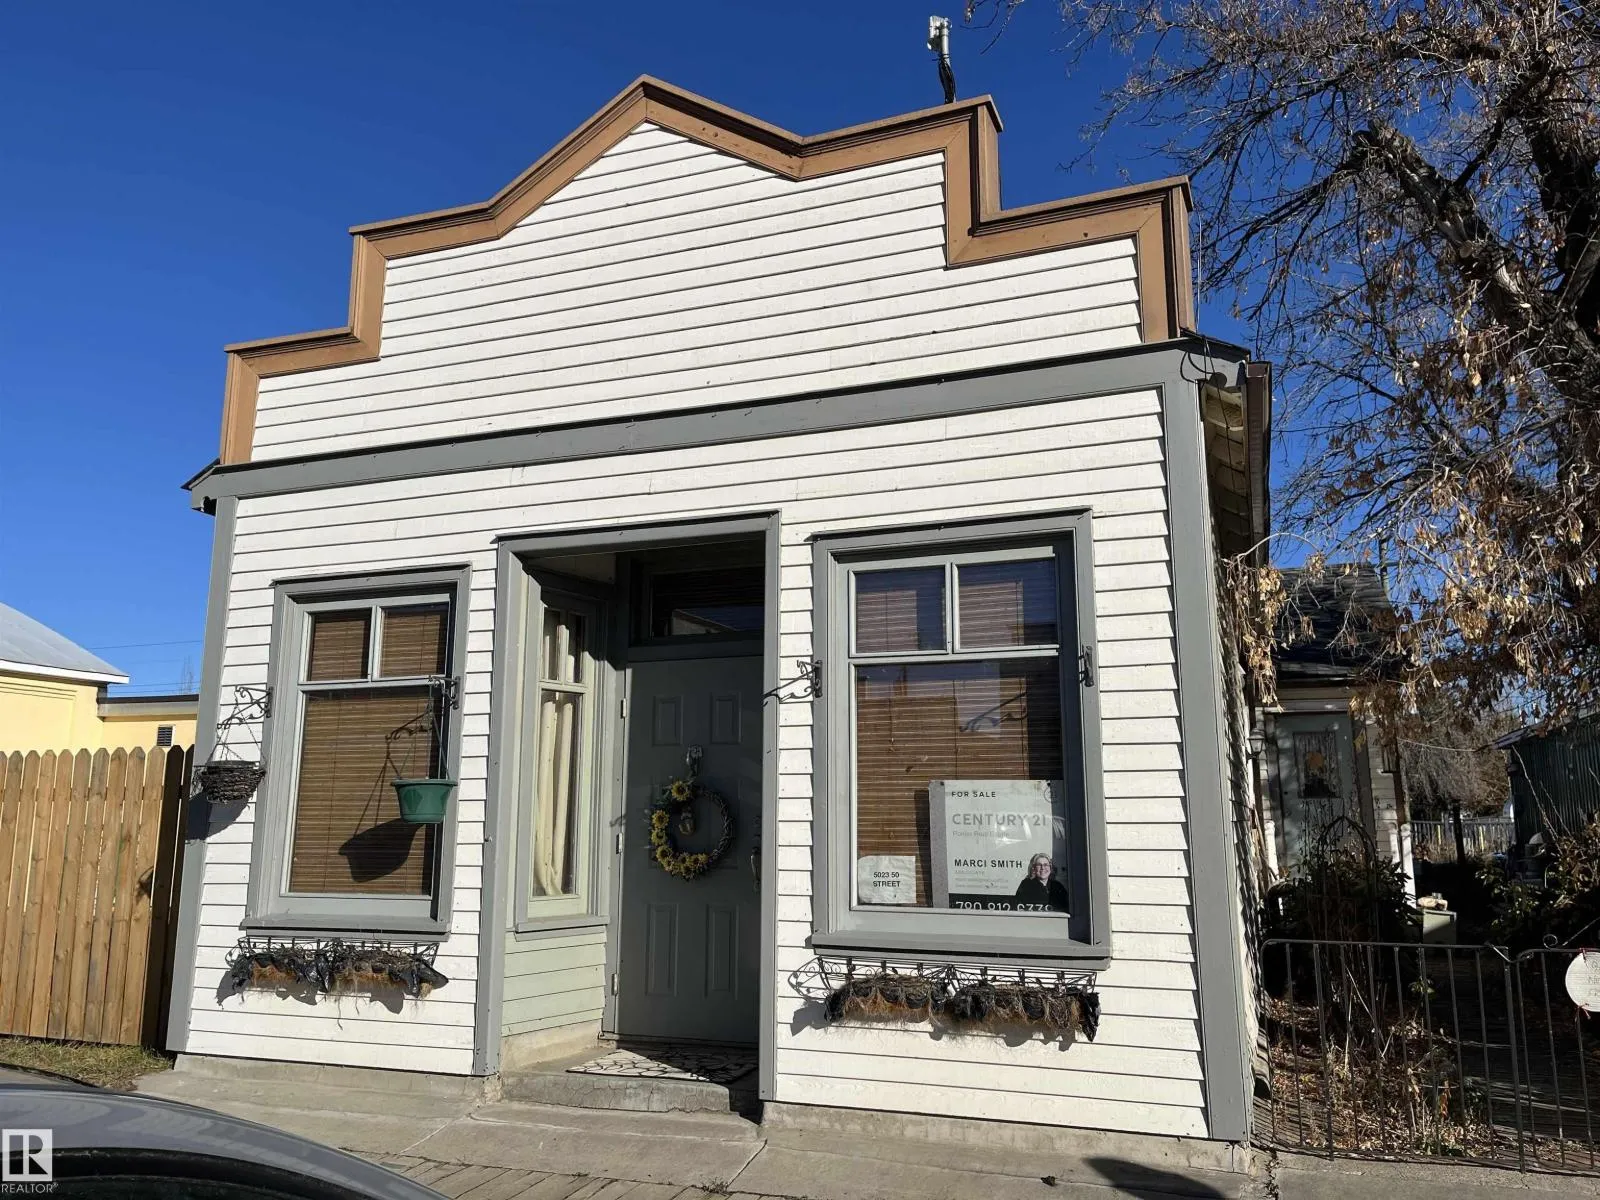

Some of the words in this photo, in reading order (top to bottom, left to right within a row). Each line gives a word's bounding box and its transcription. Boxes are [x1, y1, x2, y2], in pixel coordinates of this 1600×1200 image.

[952, 813, 1028, 826] CENTURY
[1033, 814, 1046, 826] 21
[954, 859, 987, 868] MARCI
[991, 860, 1023, 869] SMITH
